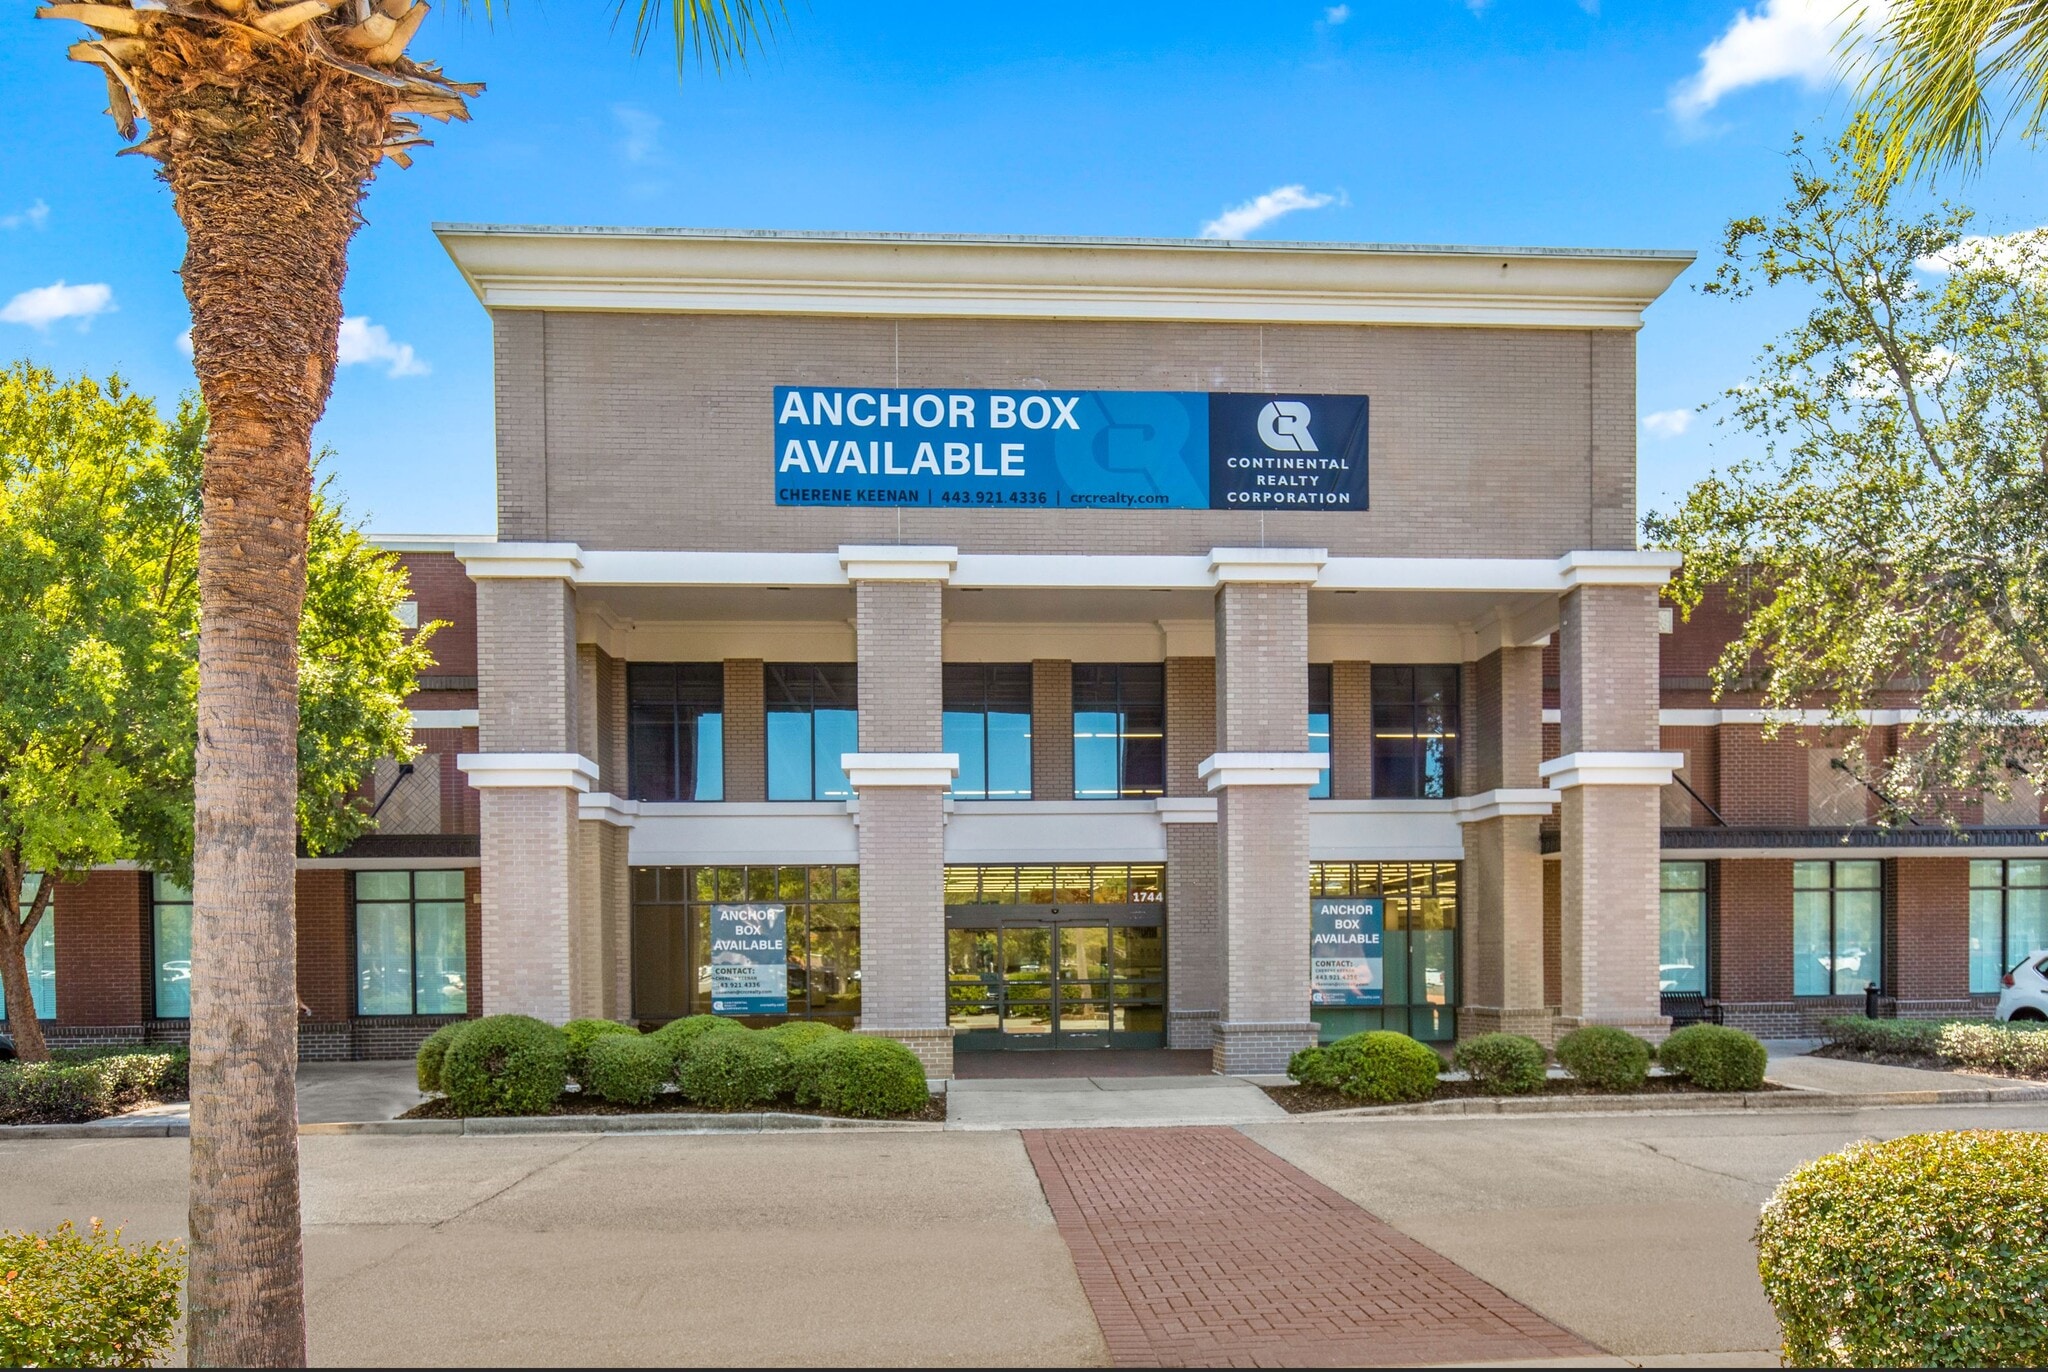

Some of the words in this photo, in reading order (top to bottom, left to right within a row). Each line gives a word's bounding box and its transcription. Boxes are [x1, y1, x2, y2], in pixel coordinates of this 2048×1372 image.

[779, 391, 975, 428] ANCHOR
[990, 395, 1081, 430] BOX
[779, 439, 1026, 476] AVAILABLE
[1227, 457, 1349, 470] CONTINENTAL
[1257, 475, 1319, 487] REALTY
[779, 488, 852, 501] CHERENE
[857, 489, 919, 503] KEENAN
[941, 491, 1047, 504] 443.921.4336
[1070, 491, 1169, 505] crcrealty.com
[1227, 492, 1350, 504] CORPORATION
[1133, 892, 1163, 903] 1744
[720, 910, 775, 920] ANCHOR
[1321, 905, 1373, 915] ANCHOR
[735, 925, 761, 935] BOX
[1335, 920, 1359, 929] BOX
[1315, 934, 1379, 944] AVAILABLE
[713, 940, 783, 950] AVAILABLE
